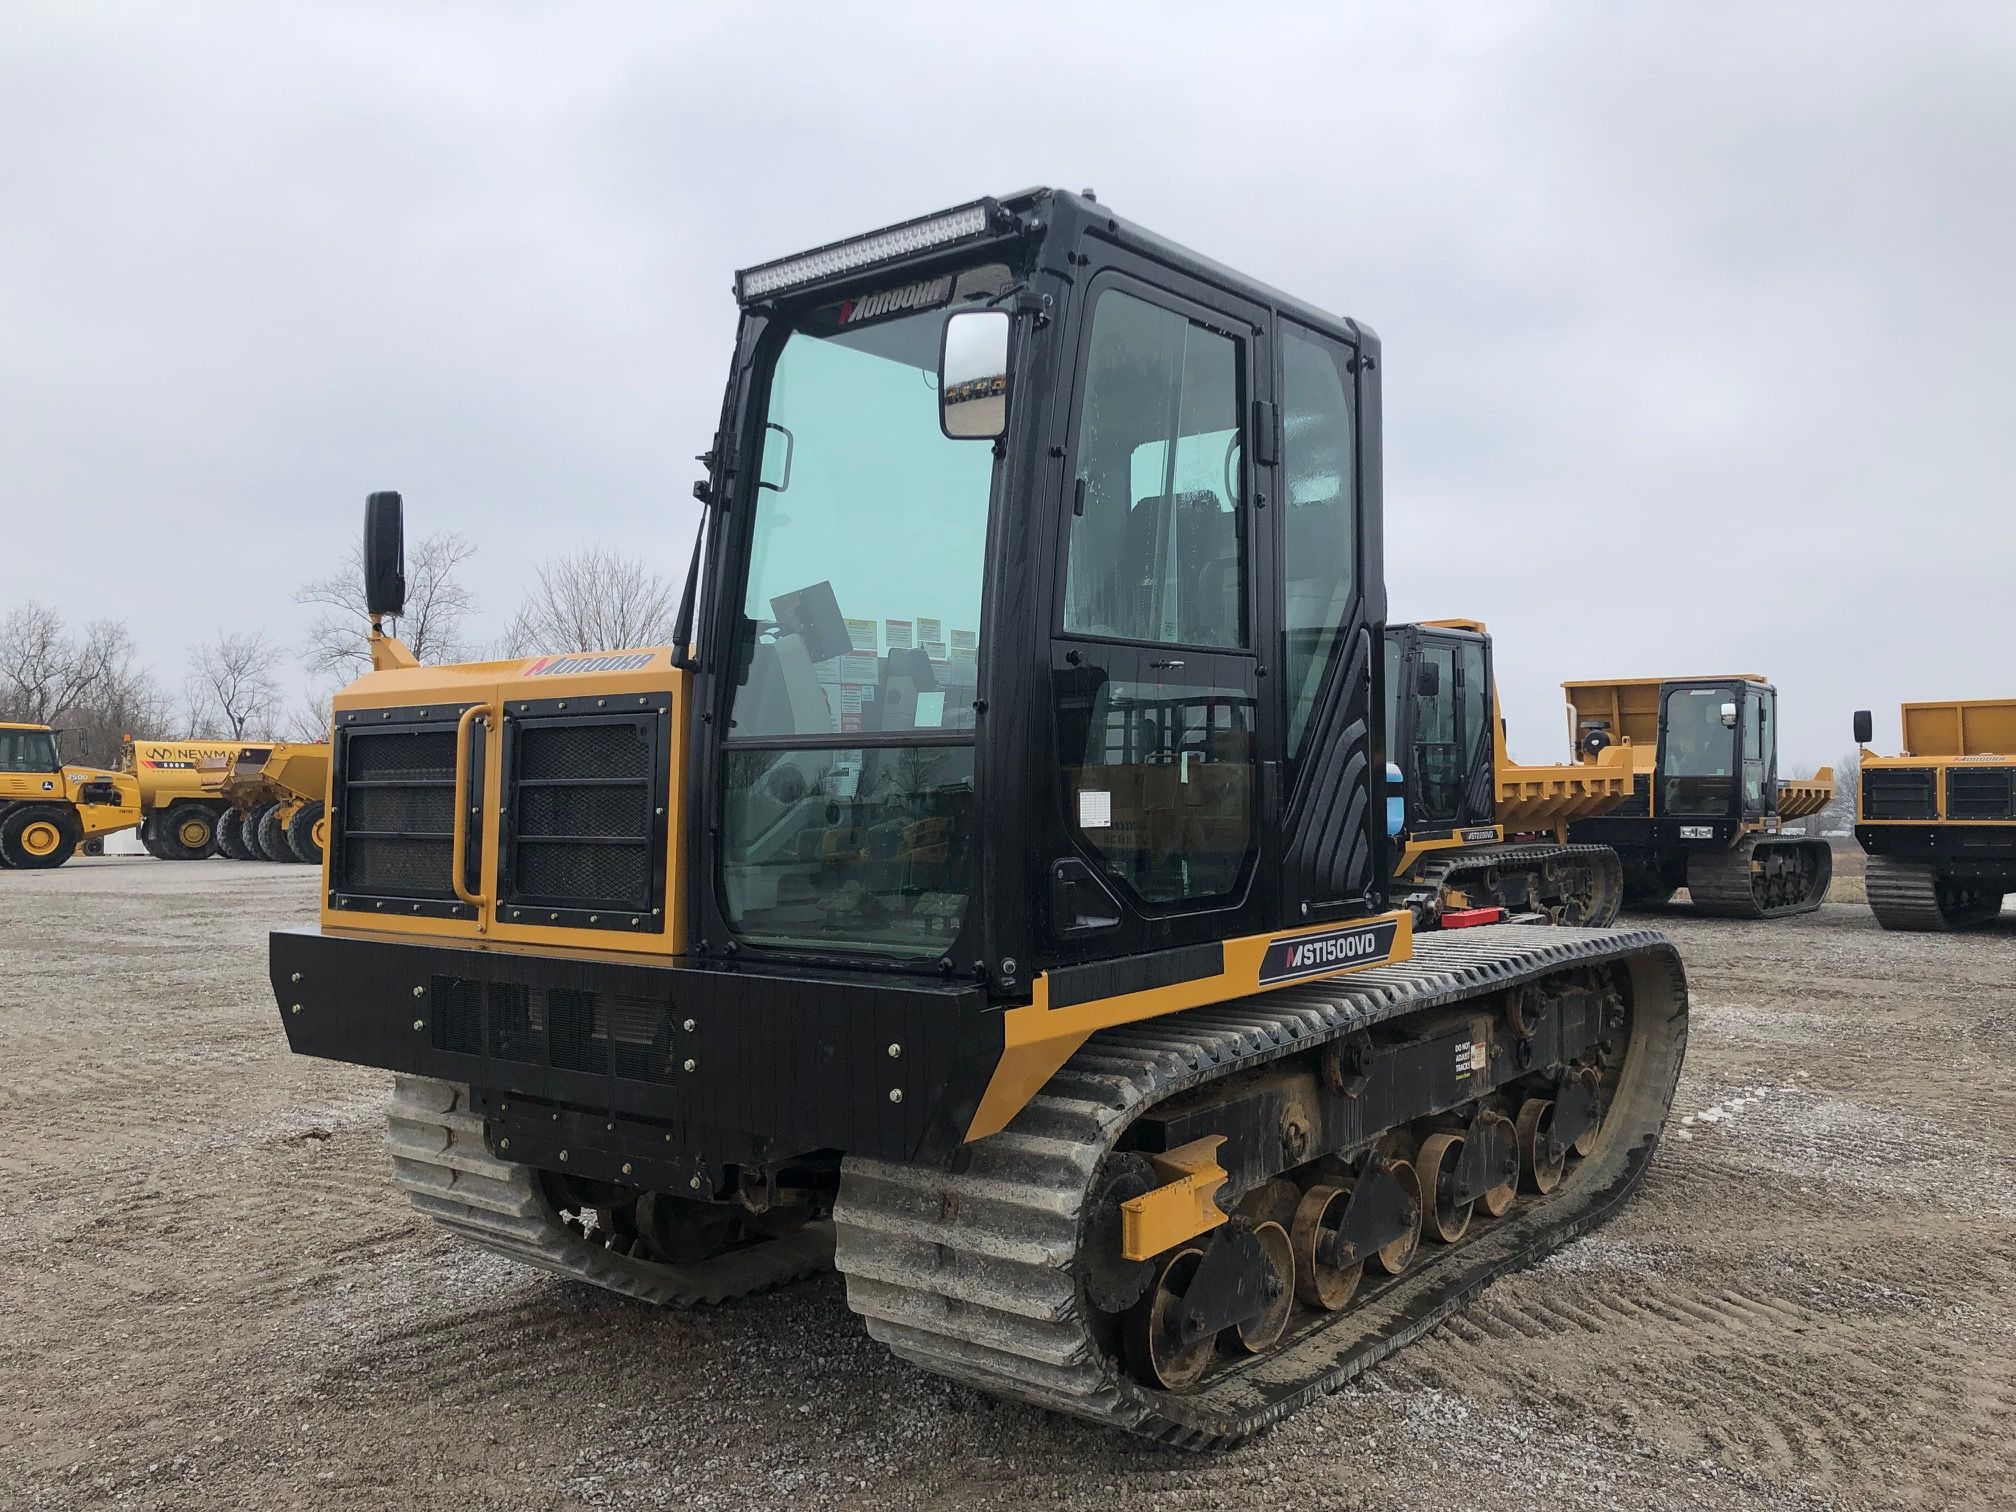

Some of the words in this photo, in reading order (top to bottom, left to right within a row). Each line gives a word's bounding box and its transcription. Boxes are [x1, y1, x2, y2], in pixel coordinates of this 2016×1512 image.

[523, 654, 656, 677] MOROOKA
[178, 748, 240, 759] NEWMA
[1286, 932, 1375, 968] MST1500VD
